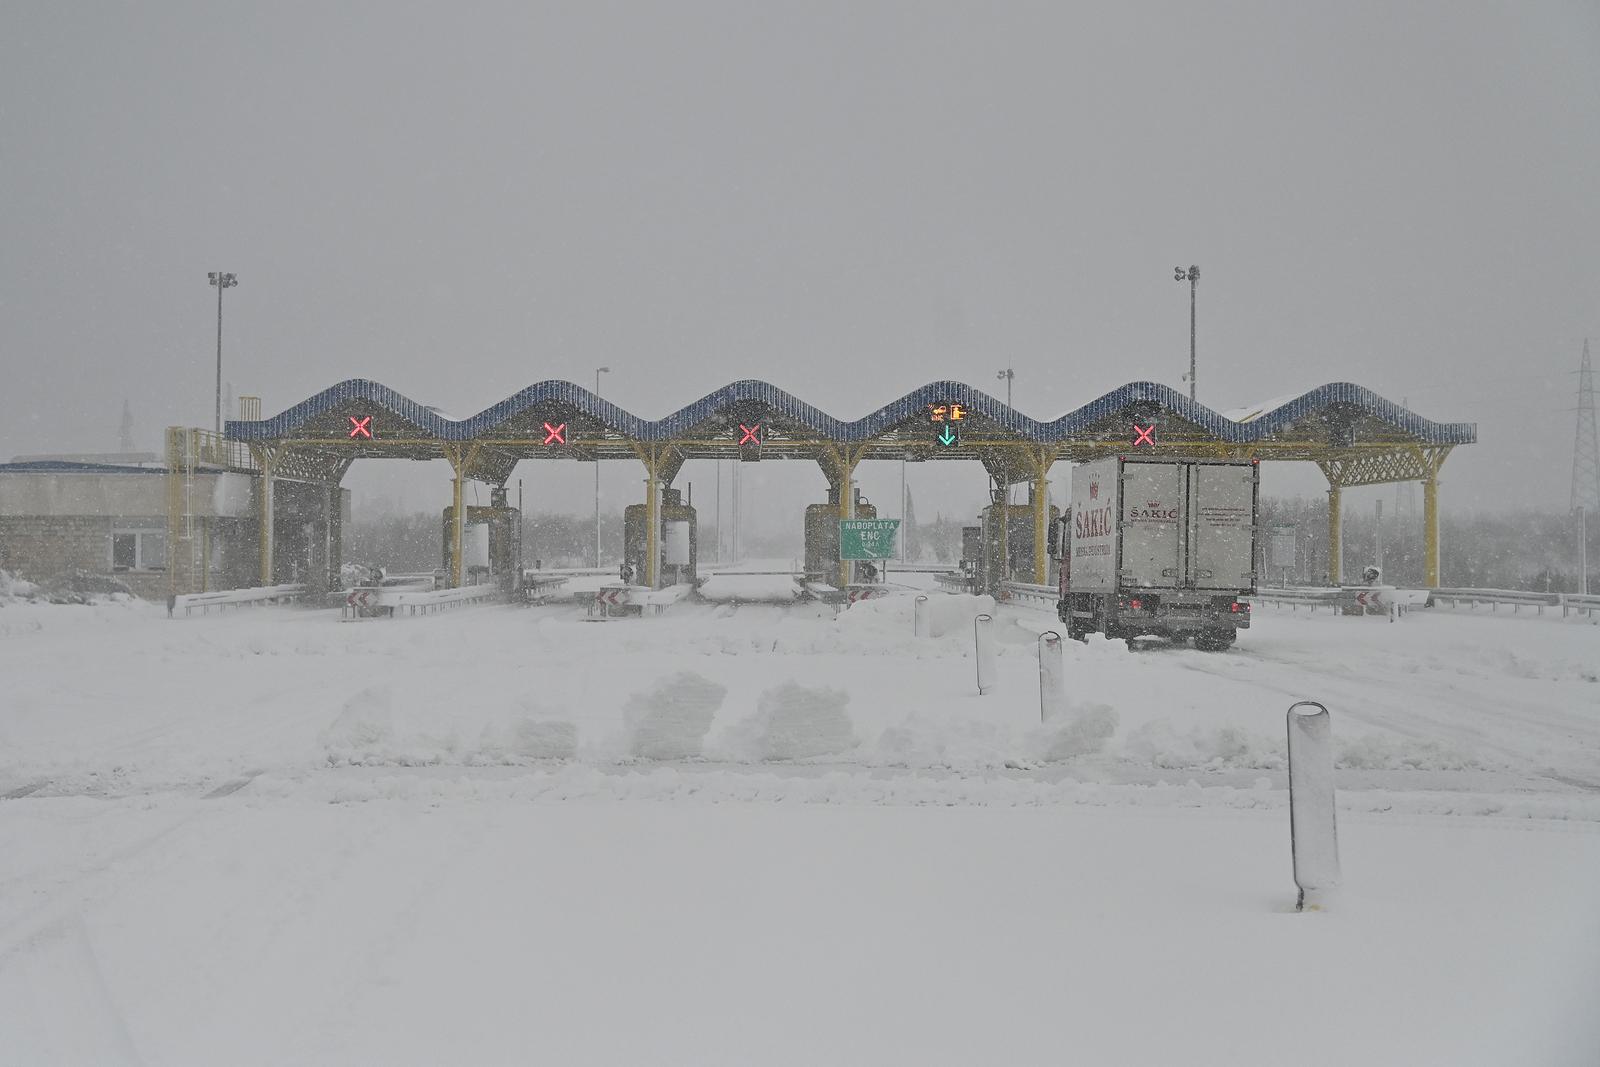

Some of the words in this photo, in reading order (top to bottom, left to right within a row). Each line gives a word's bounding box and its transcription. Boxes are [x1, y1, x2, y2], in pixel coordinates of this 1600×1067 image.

[1076, 497, 1111, 539] ŠAKIĆ
[1130, 506, 1178, 519] ŠAKIĆ
[860, 530, 880, 541] ENC
